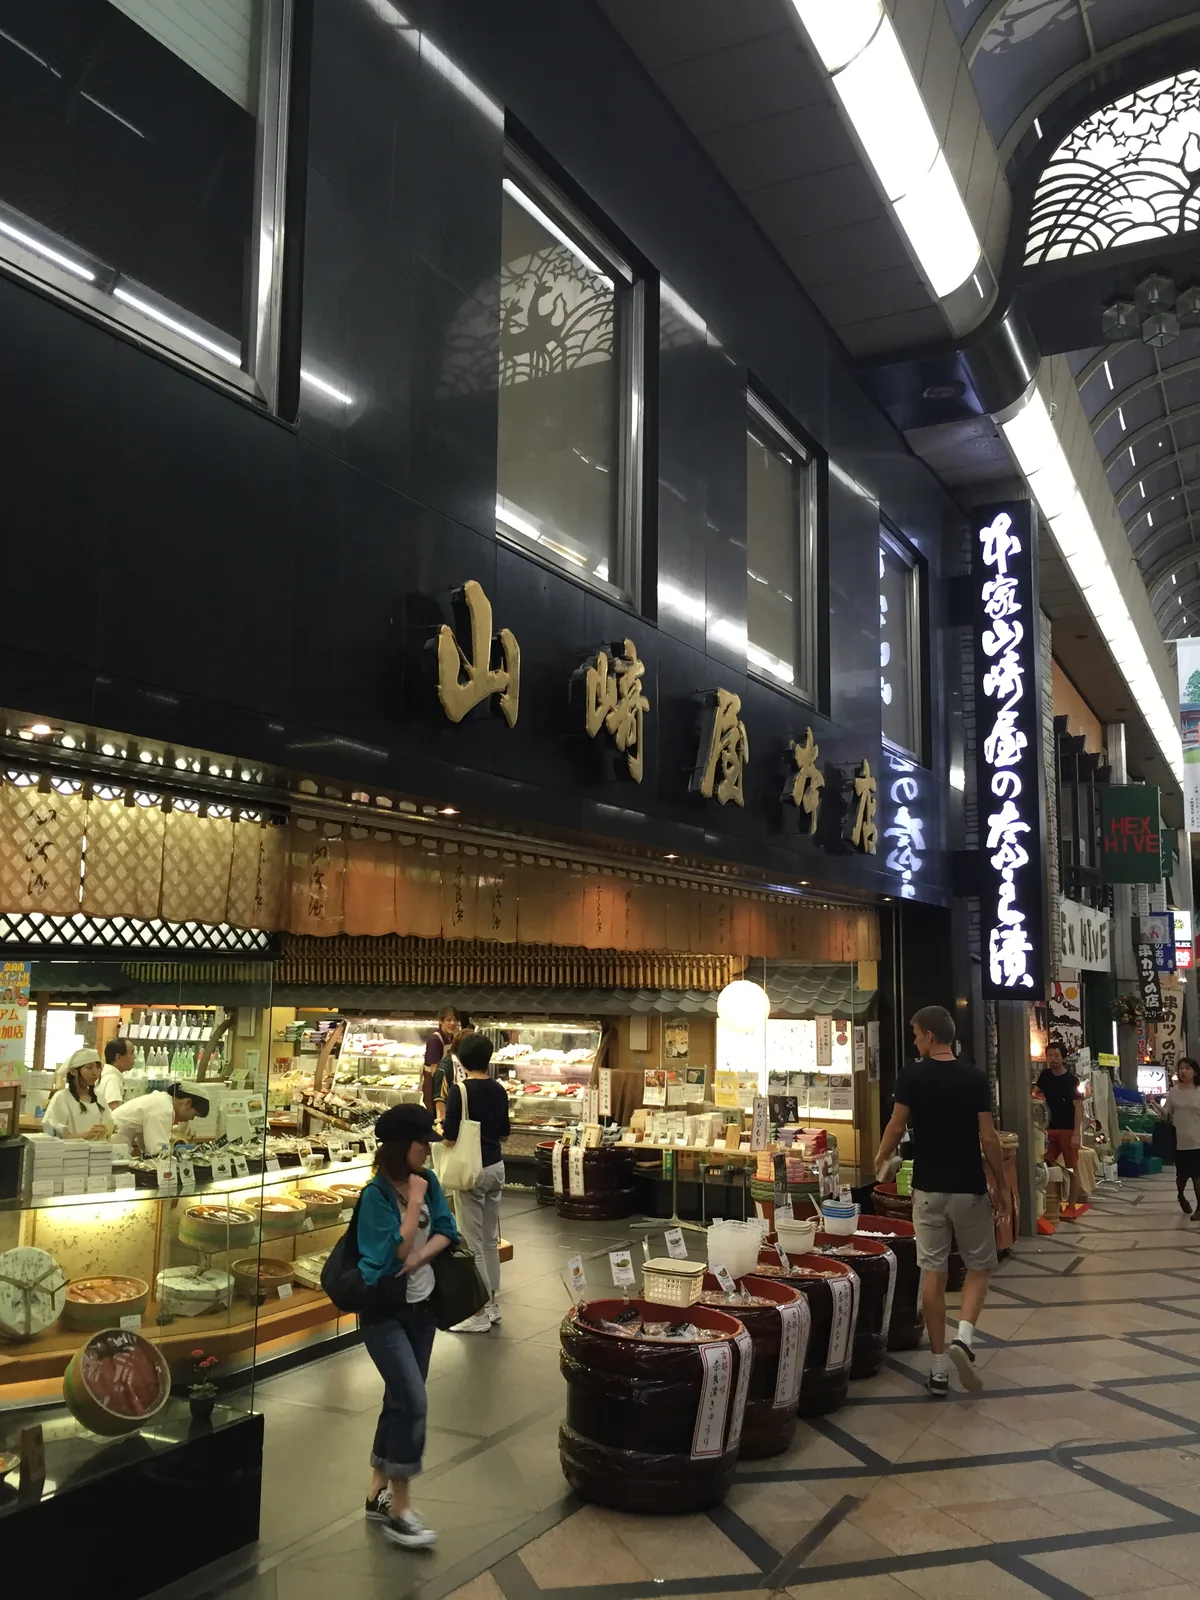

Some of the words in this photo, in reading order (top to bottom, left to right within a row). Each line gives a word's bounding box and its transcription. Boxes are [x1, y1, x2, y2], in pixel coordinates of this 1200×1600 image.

[1111, 816, 1152, 835] HEX
[1104, 834, 1160, 854] HIVE
[1138, 944, 1160, 1008] 串カツの店
[0, 1024, 24, 1039] 加店
[755, 1102, 763, 1147] わらびもち
[703, 1359, 721, 1448] 奈良漬きゅうり
